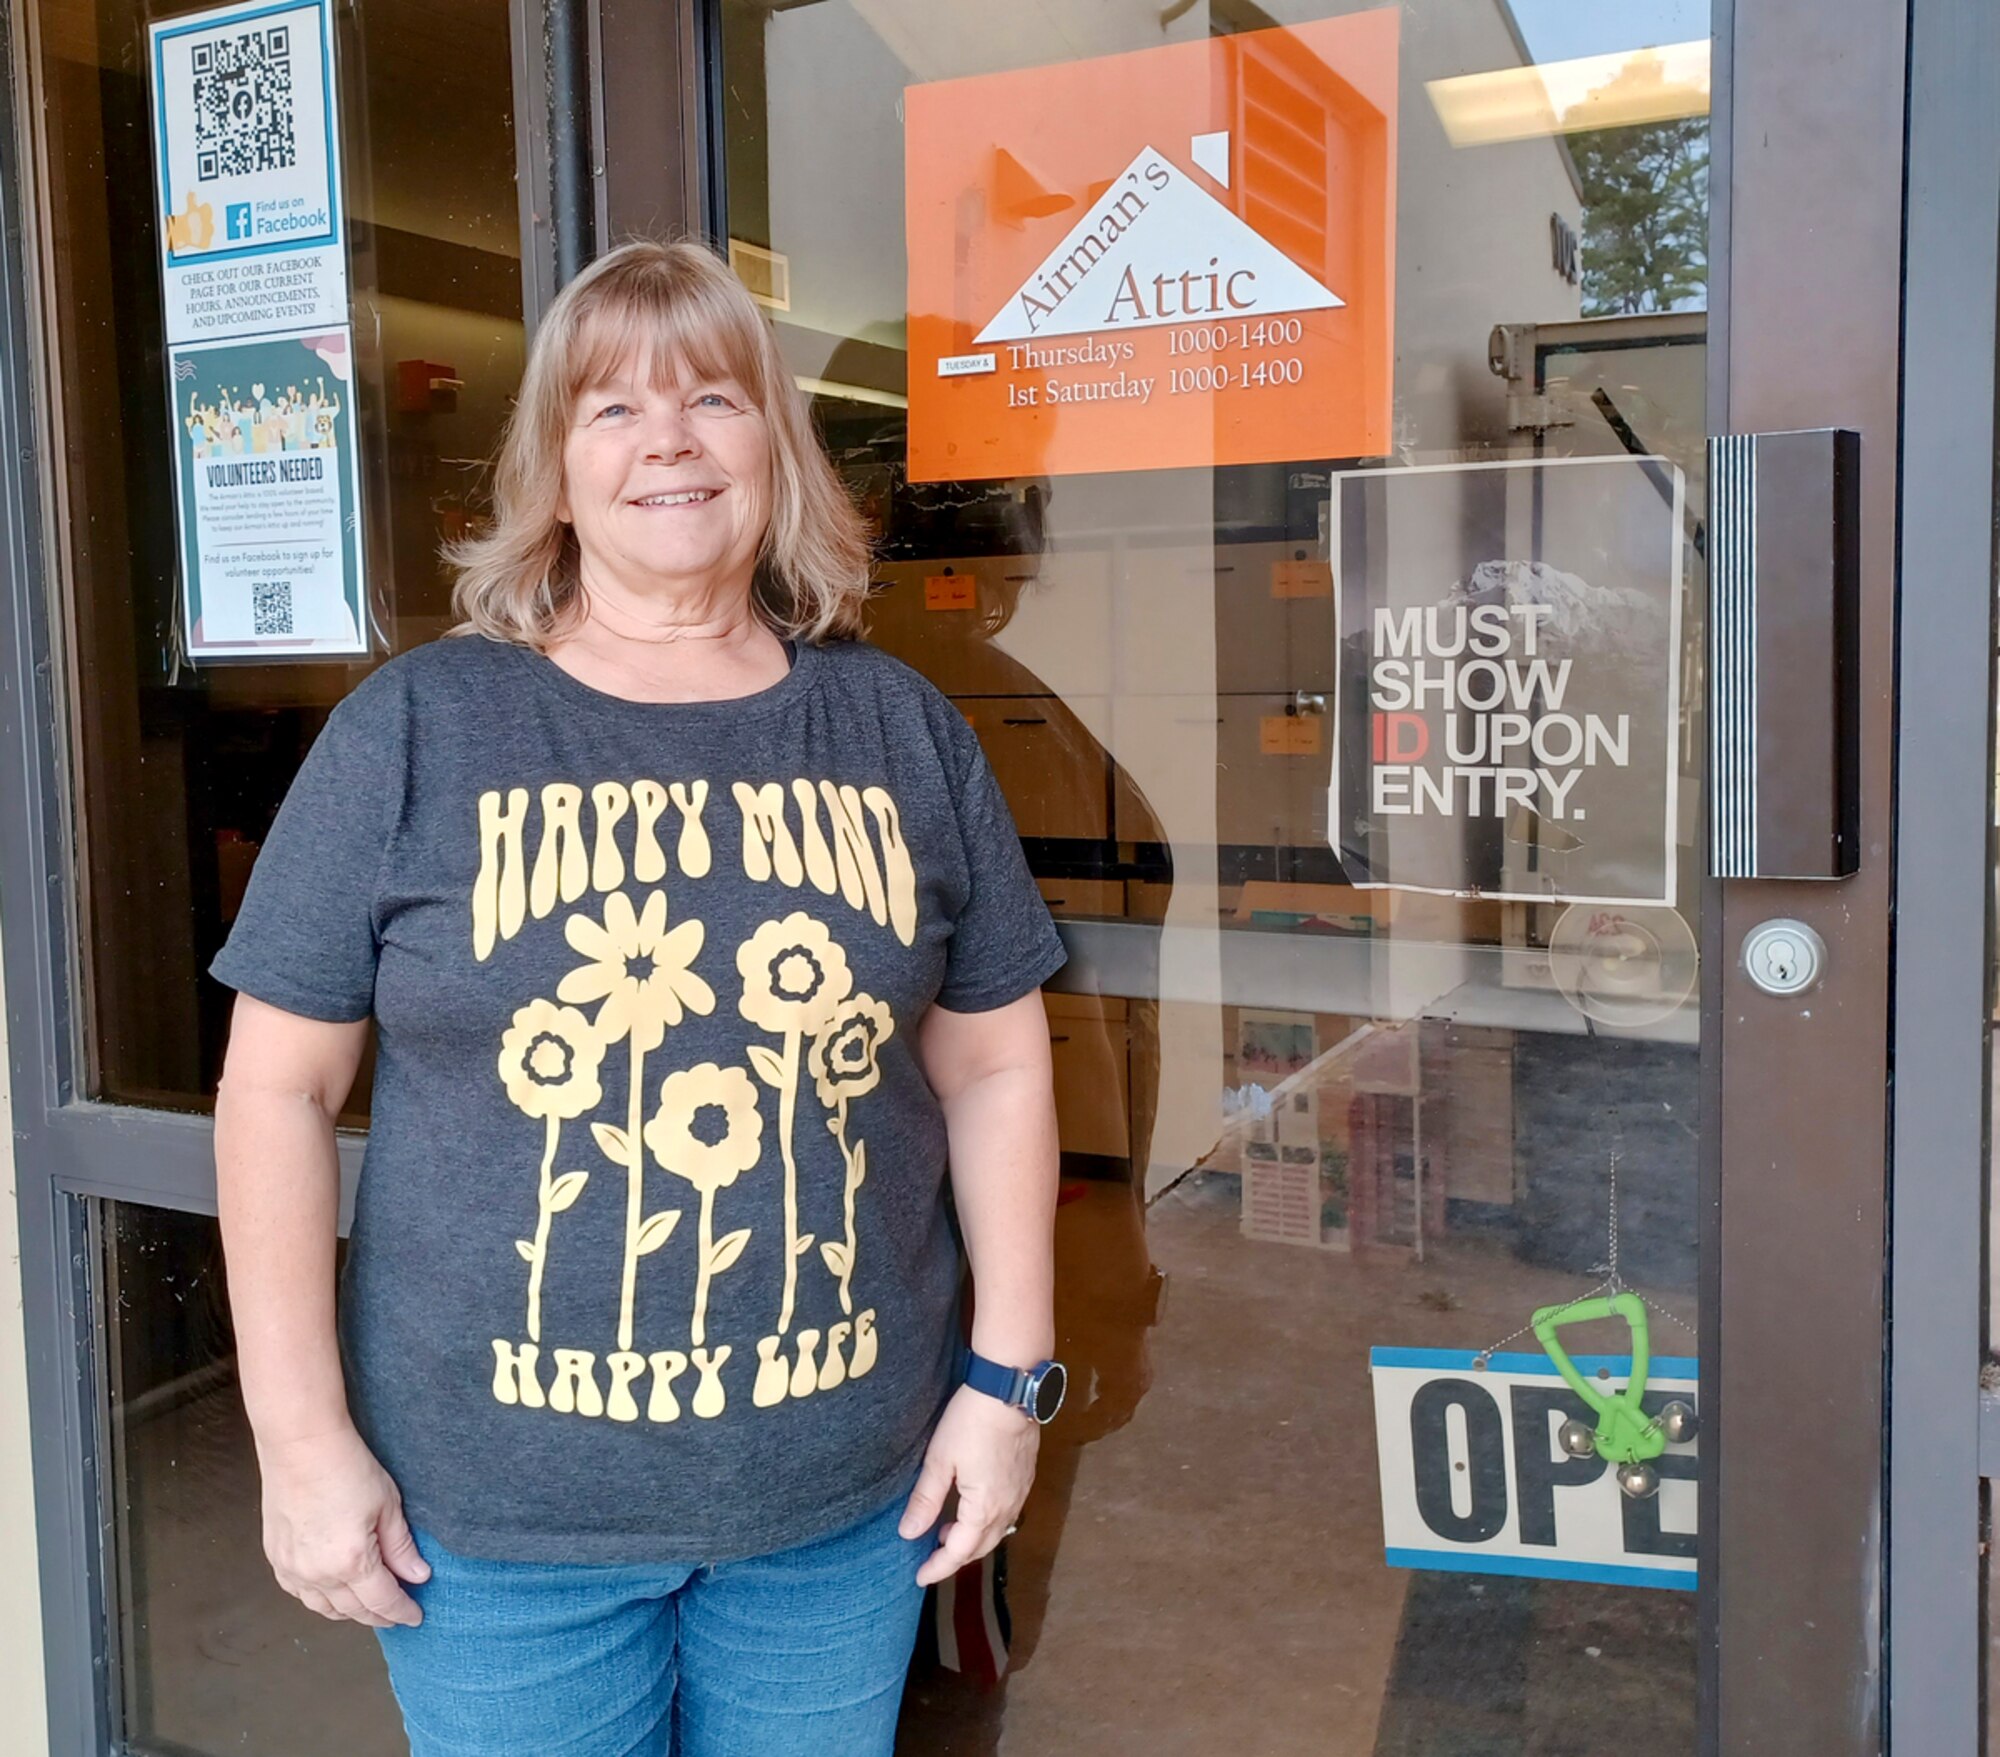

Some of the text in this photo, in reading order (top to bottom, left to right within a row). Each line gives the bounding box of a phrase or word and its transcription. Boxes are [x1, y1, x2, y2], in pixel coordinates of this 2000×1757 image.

[256, 198, 304, 212] Find us on
[257, 209, 326, 234] Facebook
[182, 256, 322, 285] CHECK OUT OUR FACEBOOK
[1018, 161, 1171, 334] Airman's
[190, 272, 313, 299] PAGE FOR OUR CURRENT
[1103, 256, 1257, 323] Attic
[193, 315, 215, 328] AND
[218, 307, 273, 325] UPCOMING
[946, 360, 981, 370] TUESDAY
[1007, 317, 1302, 371] Thursdays 1000-1400
[1007, 358, 1303, 408] 1st Saturday 1000-1400
[206, 457, 323, 488] VOLUNTEERS NEEDED
[205, 547, 333, 564] Find us on Facebook to sign up for
[225, 566, 260, 577] volunteer
[1373, 604, 1552, 658] MUST
[1370, 659, 1572, 711] SHOW
[1373, 713, 1629, 766] ID UPON
[1373, 765, 1585, 820] ENTRY.
[472, 778, 918, 962] HAPPY MIND
[491, 1308, 879, 1423] HAPPY LIFE
